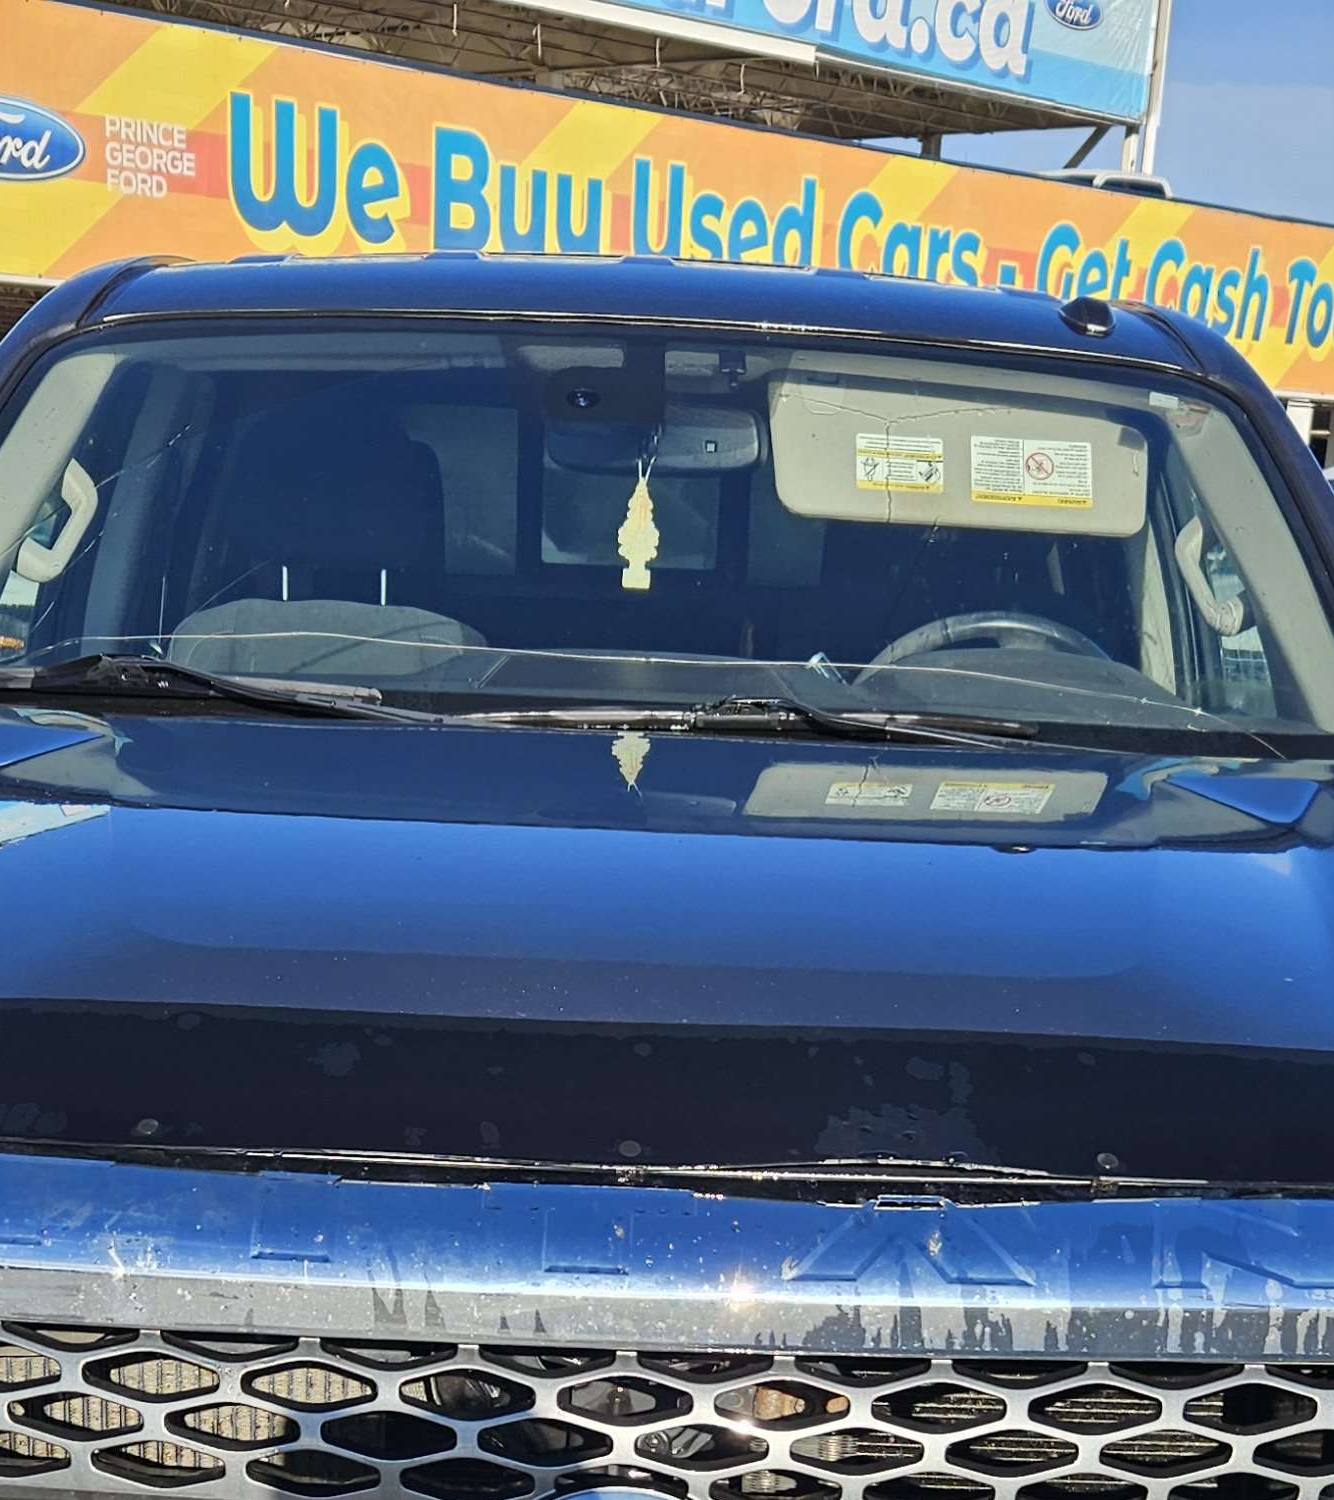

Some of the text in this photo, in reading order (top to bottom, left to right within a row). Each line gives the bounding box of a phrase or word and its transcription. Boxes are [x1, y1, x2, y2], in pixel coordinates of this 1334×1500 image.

[105, 114, 188, 149] PRINCE
[105, 143, 196, 176] GEORGE
[107, 169, 168, 198] FORD
[230, 91, 400, 245] We
[632, 158, 817, 267] Used
[837, 190, 982, 287] Cars
[1036, 223, 1132, 300] Get
[1146, 239, 1269, 341] Cash
